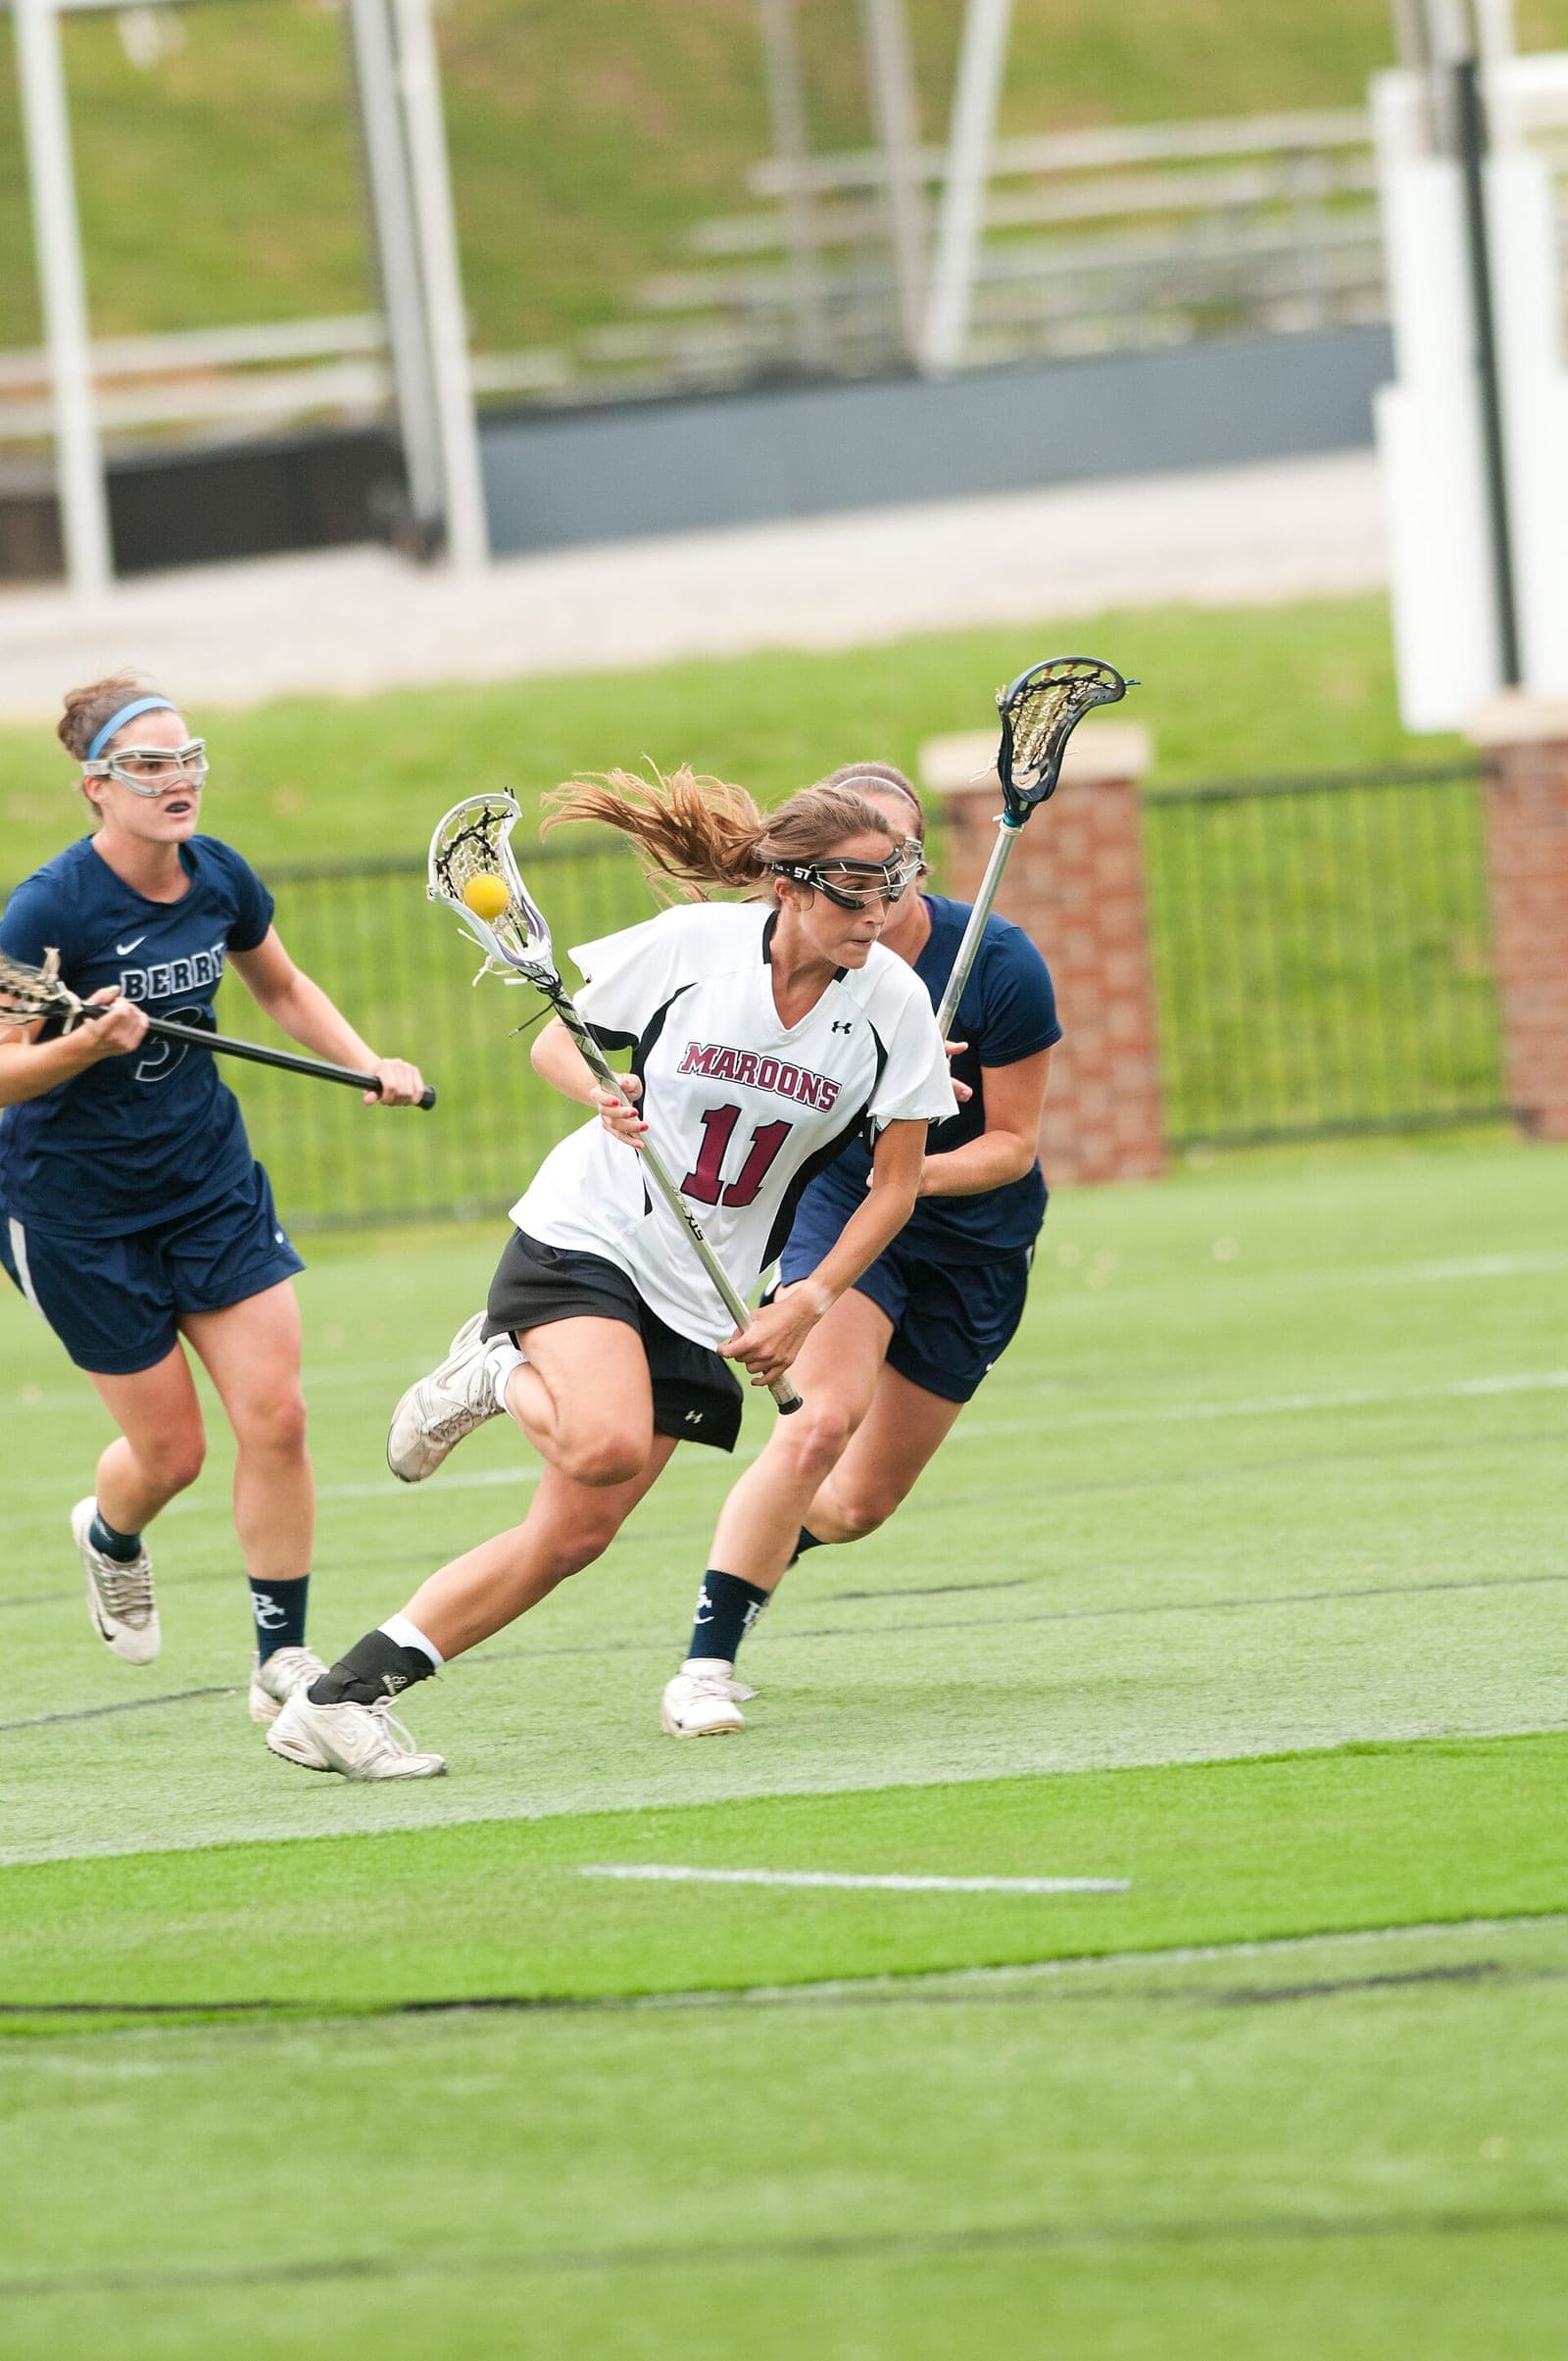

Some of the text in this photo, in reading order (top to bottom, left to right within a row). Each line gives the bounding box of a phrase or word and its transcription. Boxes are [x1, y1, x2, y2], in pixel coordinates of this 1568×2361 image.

[120, 941, 225, 1003] BERRY
[677, 1042, 843, 1113] MAROONS
[680, 1103, 794, 1208] 11
